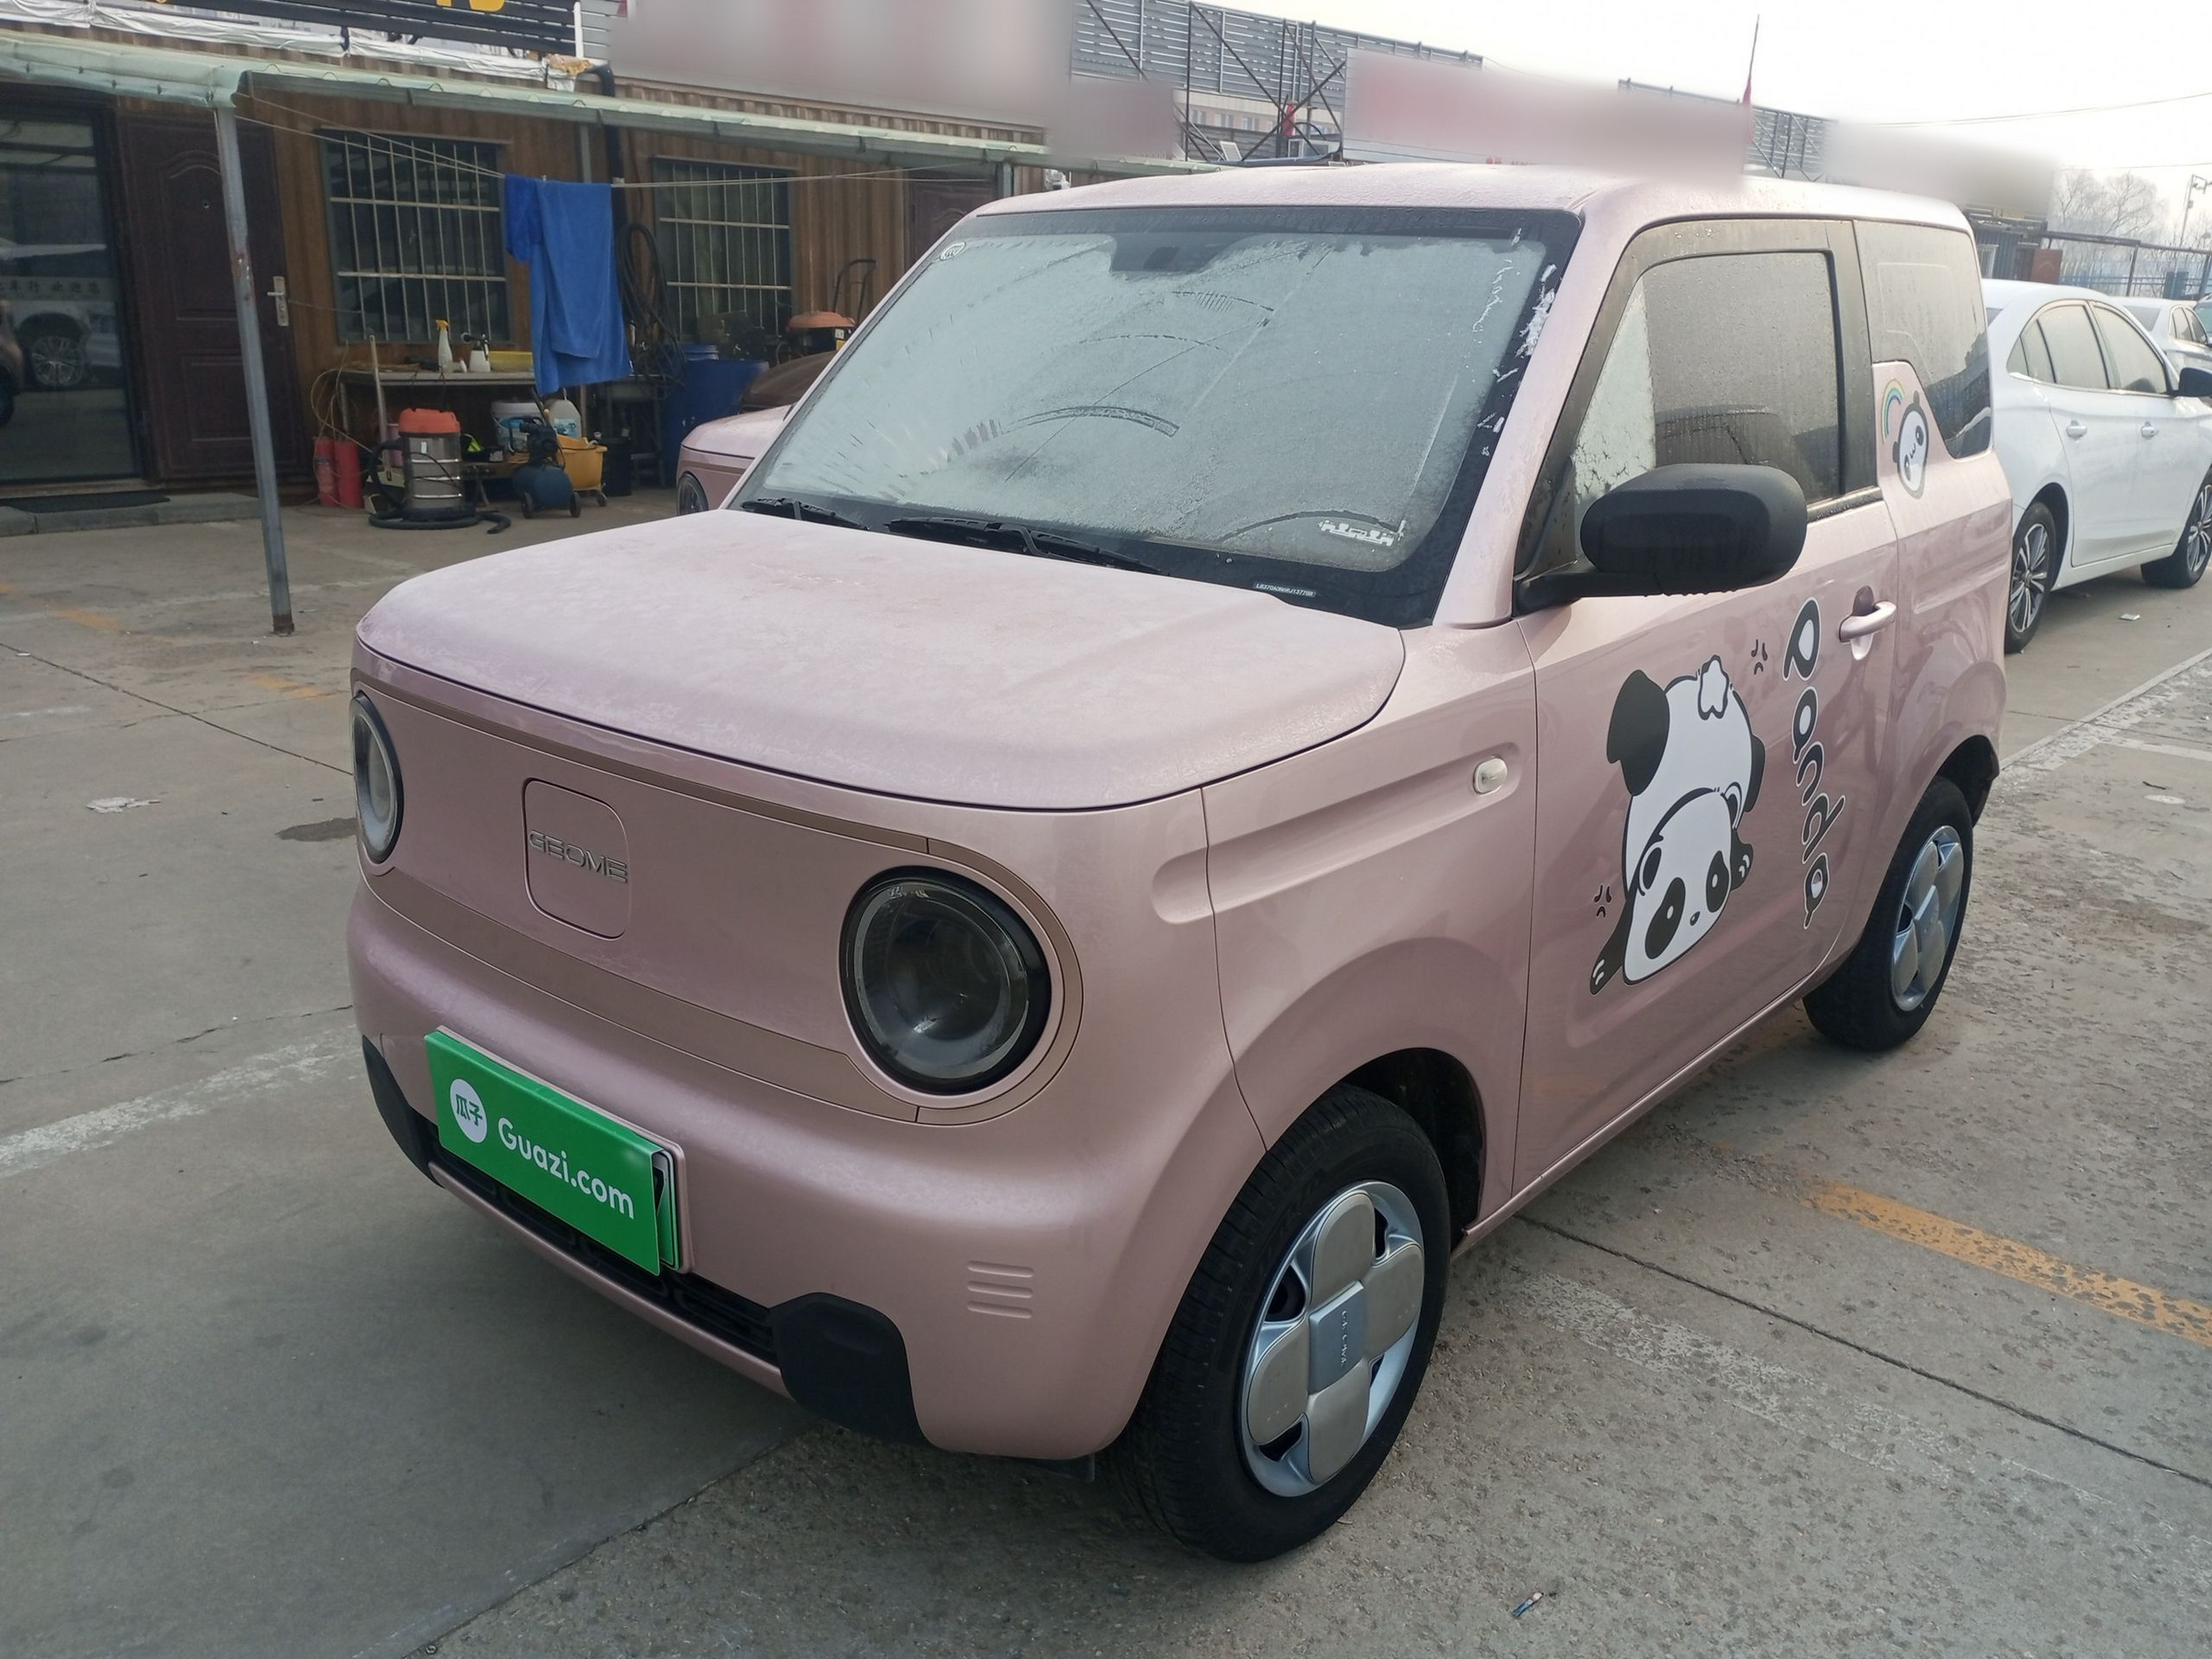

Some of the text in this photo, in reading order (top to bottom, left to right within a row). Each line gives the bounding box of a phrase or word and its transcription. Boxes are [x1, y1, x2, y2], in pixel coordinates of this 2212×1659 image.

[528, 830, 628, 884] GEOME
[455, 1093, 483, 1126] 瓜子
[498, 1118, 634, 1219] Guazi.com
